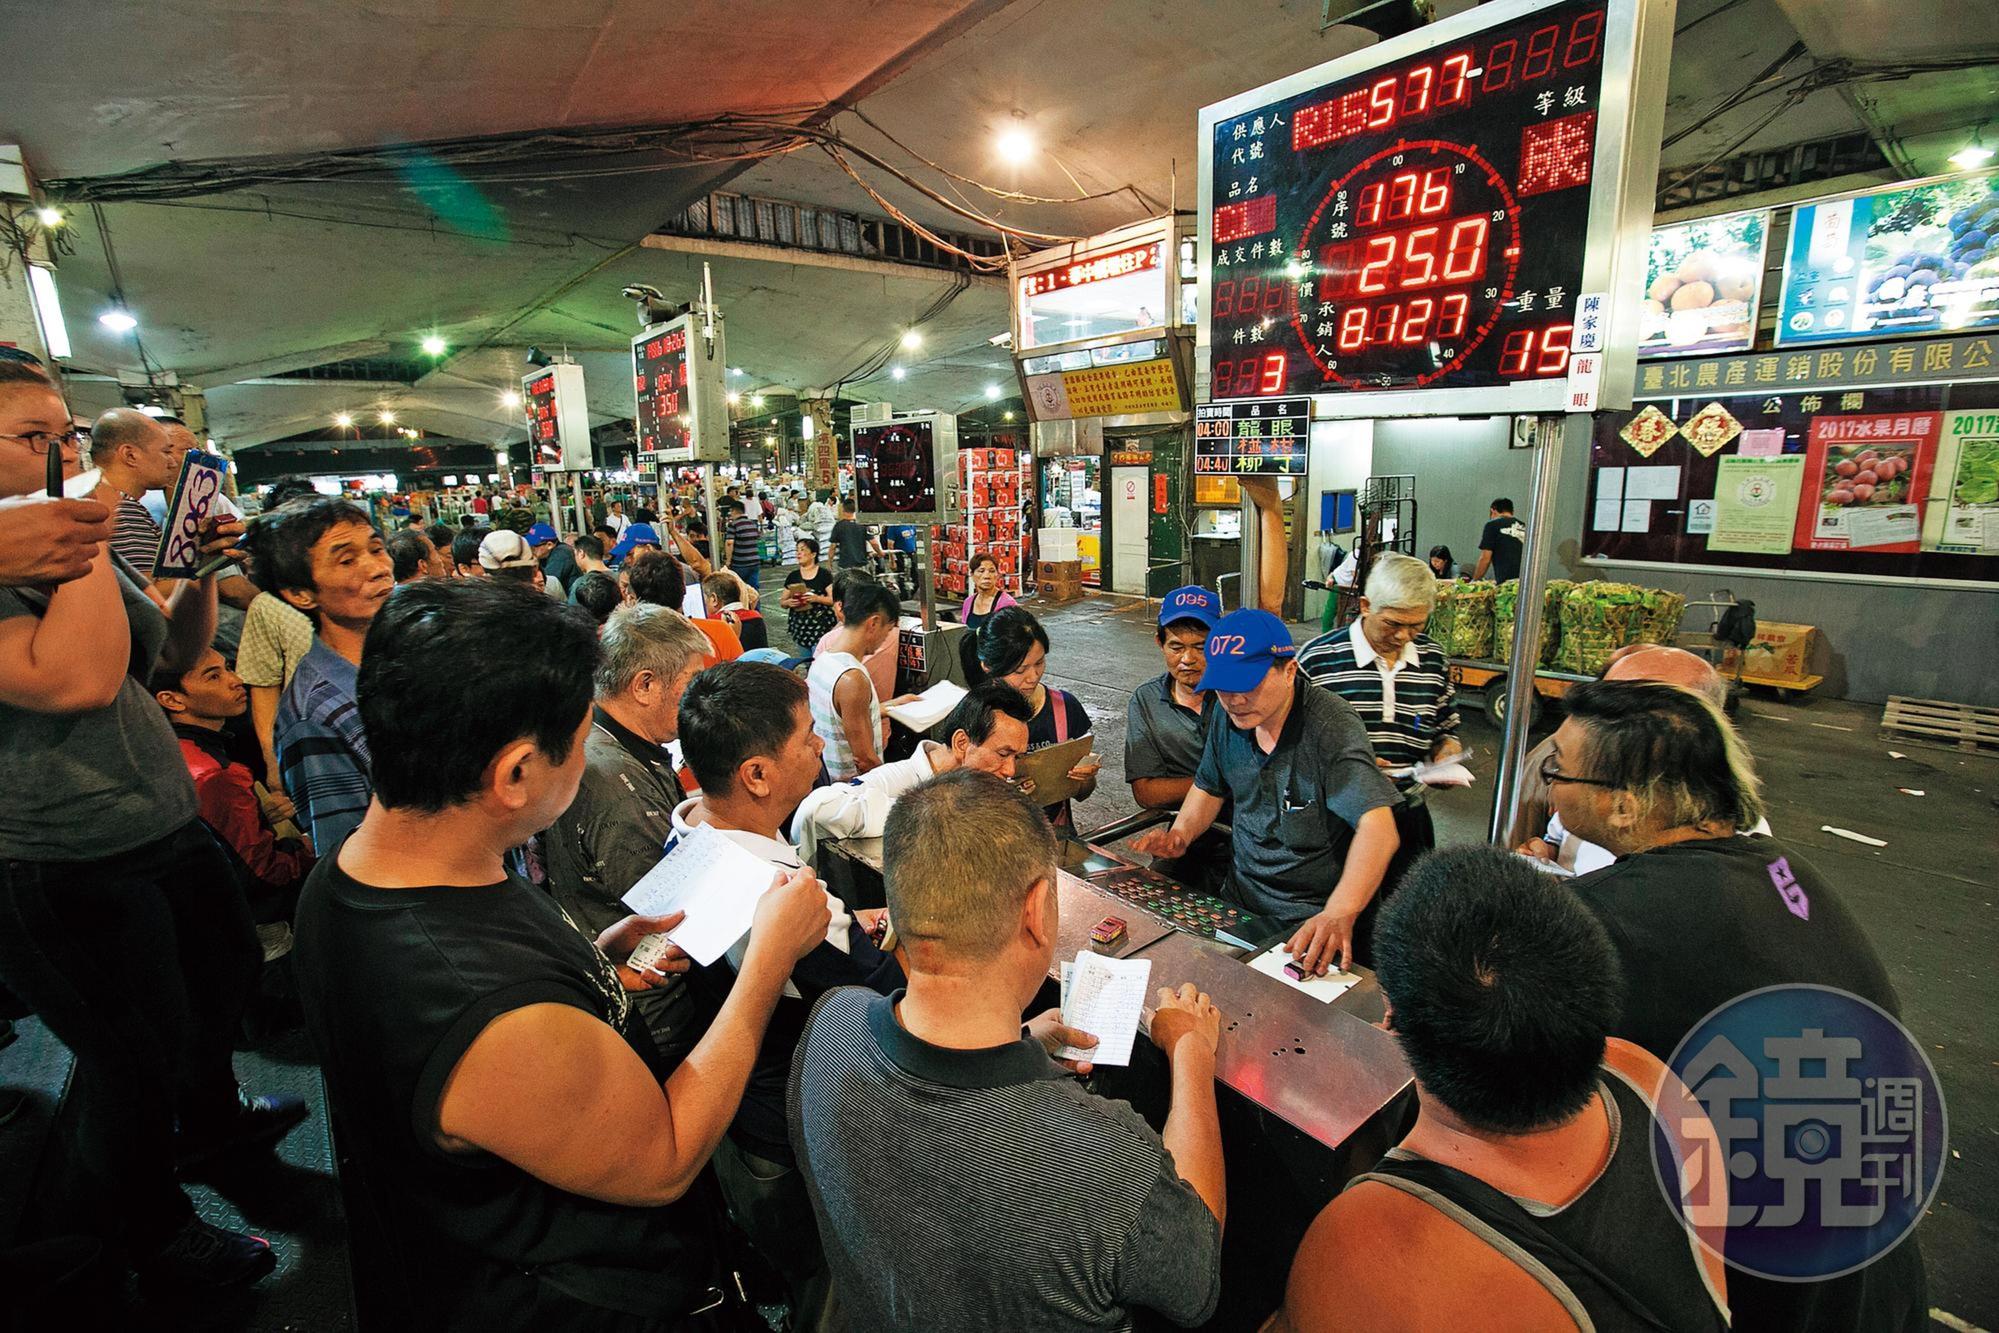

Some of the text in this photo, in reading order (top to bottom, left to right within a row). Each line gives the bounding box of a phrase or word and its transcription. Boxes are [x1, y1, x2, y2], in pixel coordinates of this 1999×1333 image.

[1534, 86, 1587, 115] 等級
[1232, 113, 1285, 141] 供應人
[1231, 141, 1264, 164] 代號
[1392, 155, 1403, 166] 00
[1454, 163, 1465, 174] 10
[1229, 176, 1258, 198] 品名
[1336, 190, 1347, 200] 90
[1372, 172, 1448, 222] 176
[1331, 200, 1348, 239] 序號
[1492, 210, 1504, 221] 20
[1216, 238, 1284, 266] 成交件數
[1359, 218, 1487, 292] 25.0
[1485, 288, 1497, 298] 30
[1516, 286, 1566, 313] 重量
[1233, 326, 1264, 345] 件數
[1316, 301, 1335, 357] 承銷人
[1443, 348, 1454, 358] 40
[1262, 355, 1284, 392] 3
[1327, 361, 1337, 370] 60
[1573, 358, 1593, 407] 龍眼
[1250, 404, 1287, 416] 品名
[1763, 392, 1864, 414] 公佈欄
[1197, 419, 1295, 437] 04:00 龍眼
[1952, 415, 1999, 435] 2017
[1235, 456, 1293, 473] 柳丁
[1175, 593, 1209, 607] 095
[1210, 635, 1246, 656] 072
